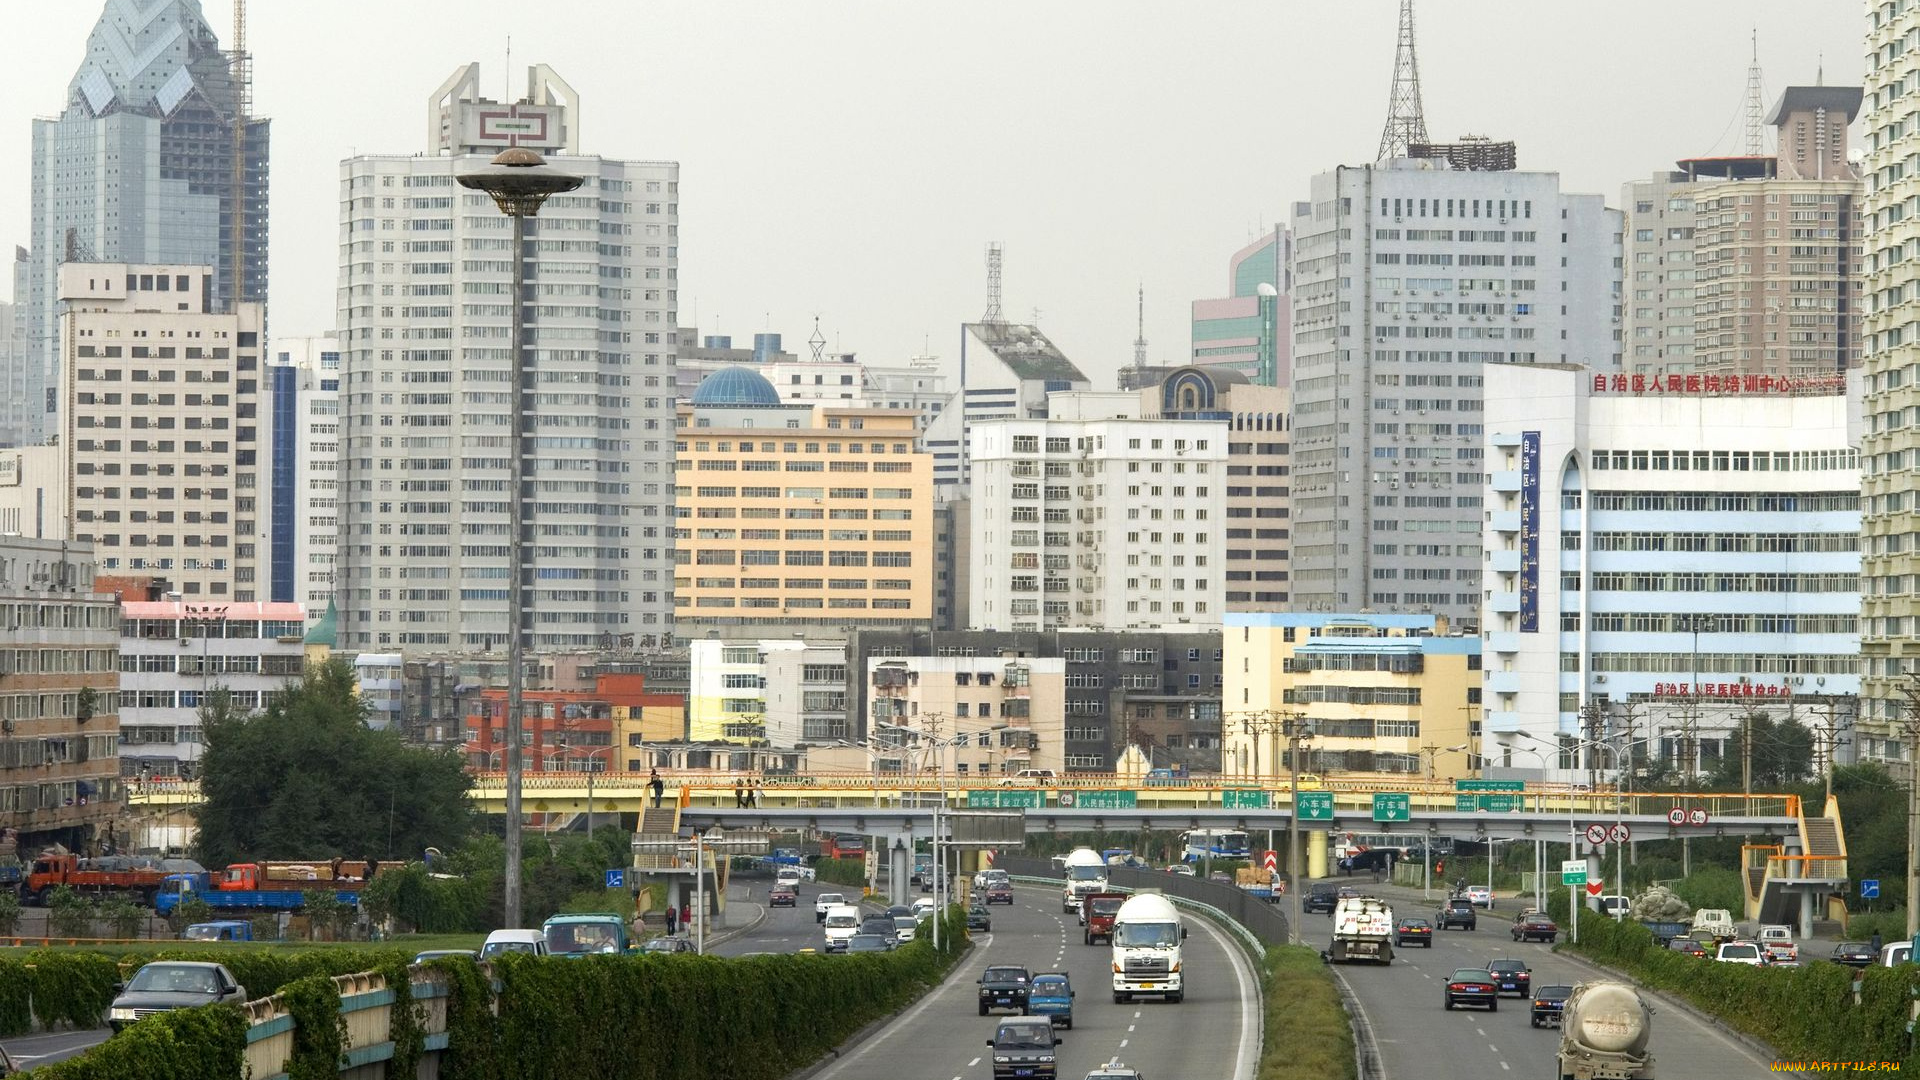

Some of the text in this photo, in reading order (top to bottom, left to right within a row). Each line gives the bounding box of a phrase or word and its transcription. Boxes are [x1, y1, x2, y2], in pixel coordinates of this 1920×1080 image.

[1594, 374, 1791, 393] 自治区人民医院培训中心
[1655, 682, 1791, 697] 自治区人民医院体检中心
[1299, 800, 1331, 809] 小车道
[1376, 801, 1406, 810] 行车道
[1672, 812, 1682, 821] 40
